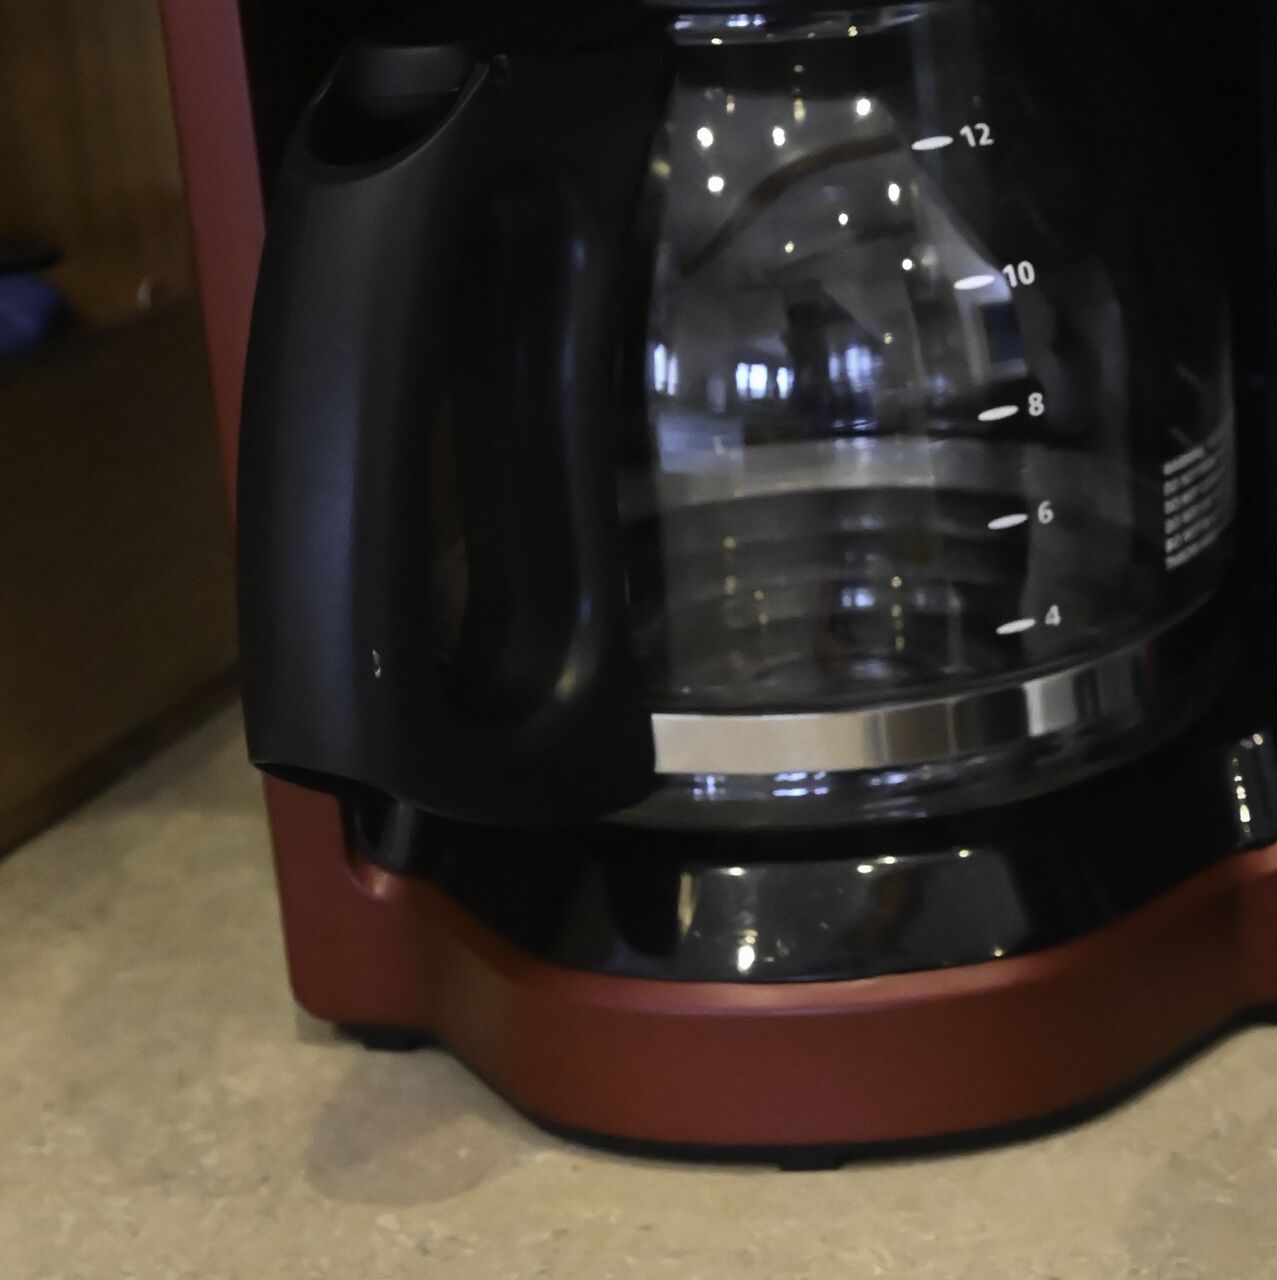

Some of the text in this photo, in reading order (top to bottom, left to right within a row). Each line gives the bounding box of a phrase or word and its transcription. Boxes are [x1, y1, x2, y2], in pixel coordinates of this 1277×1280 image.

[960, 123, 995, 147] 12
[1003, 261, 1036, 287] 10
[1028, 392, 1045, 417] 8
[1038, 501, 1054, 524] 6
[1045, 606, 1062, 628] 4
